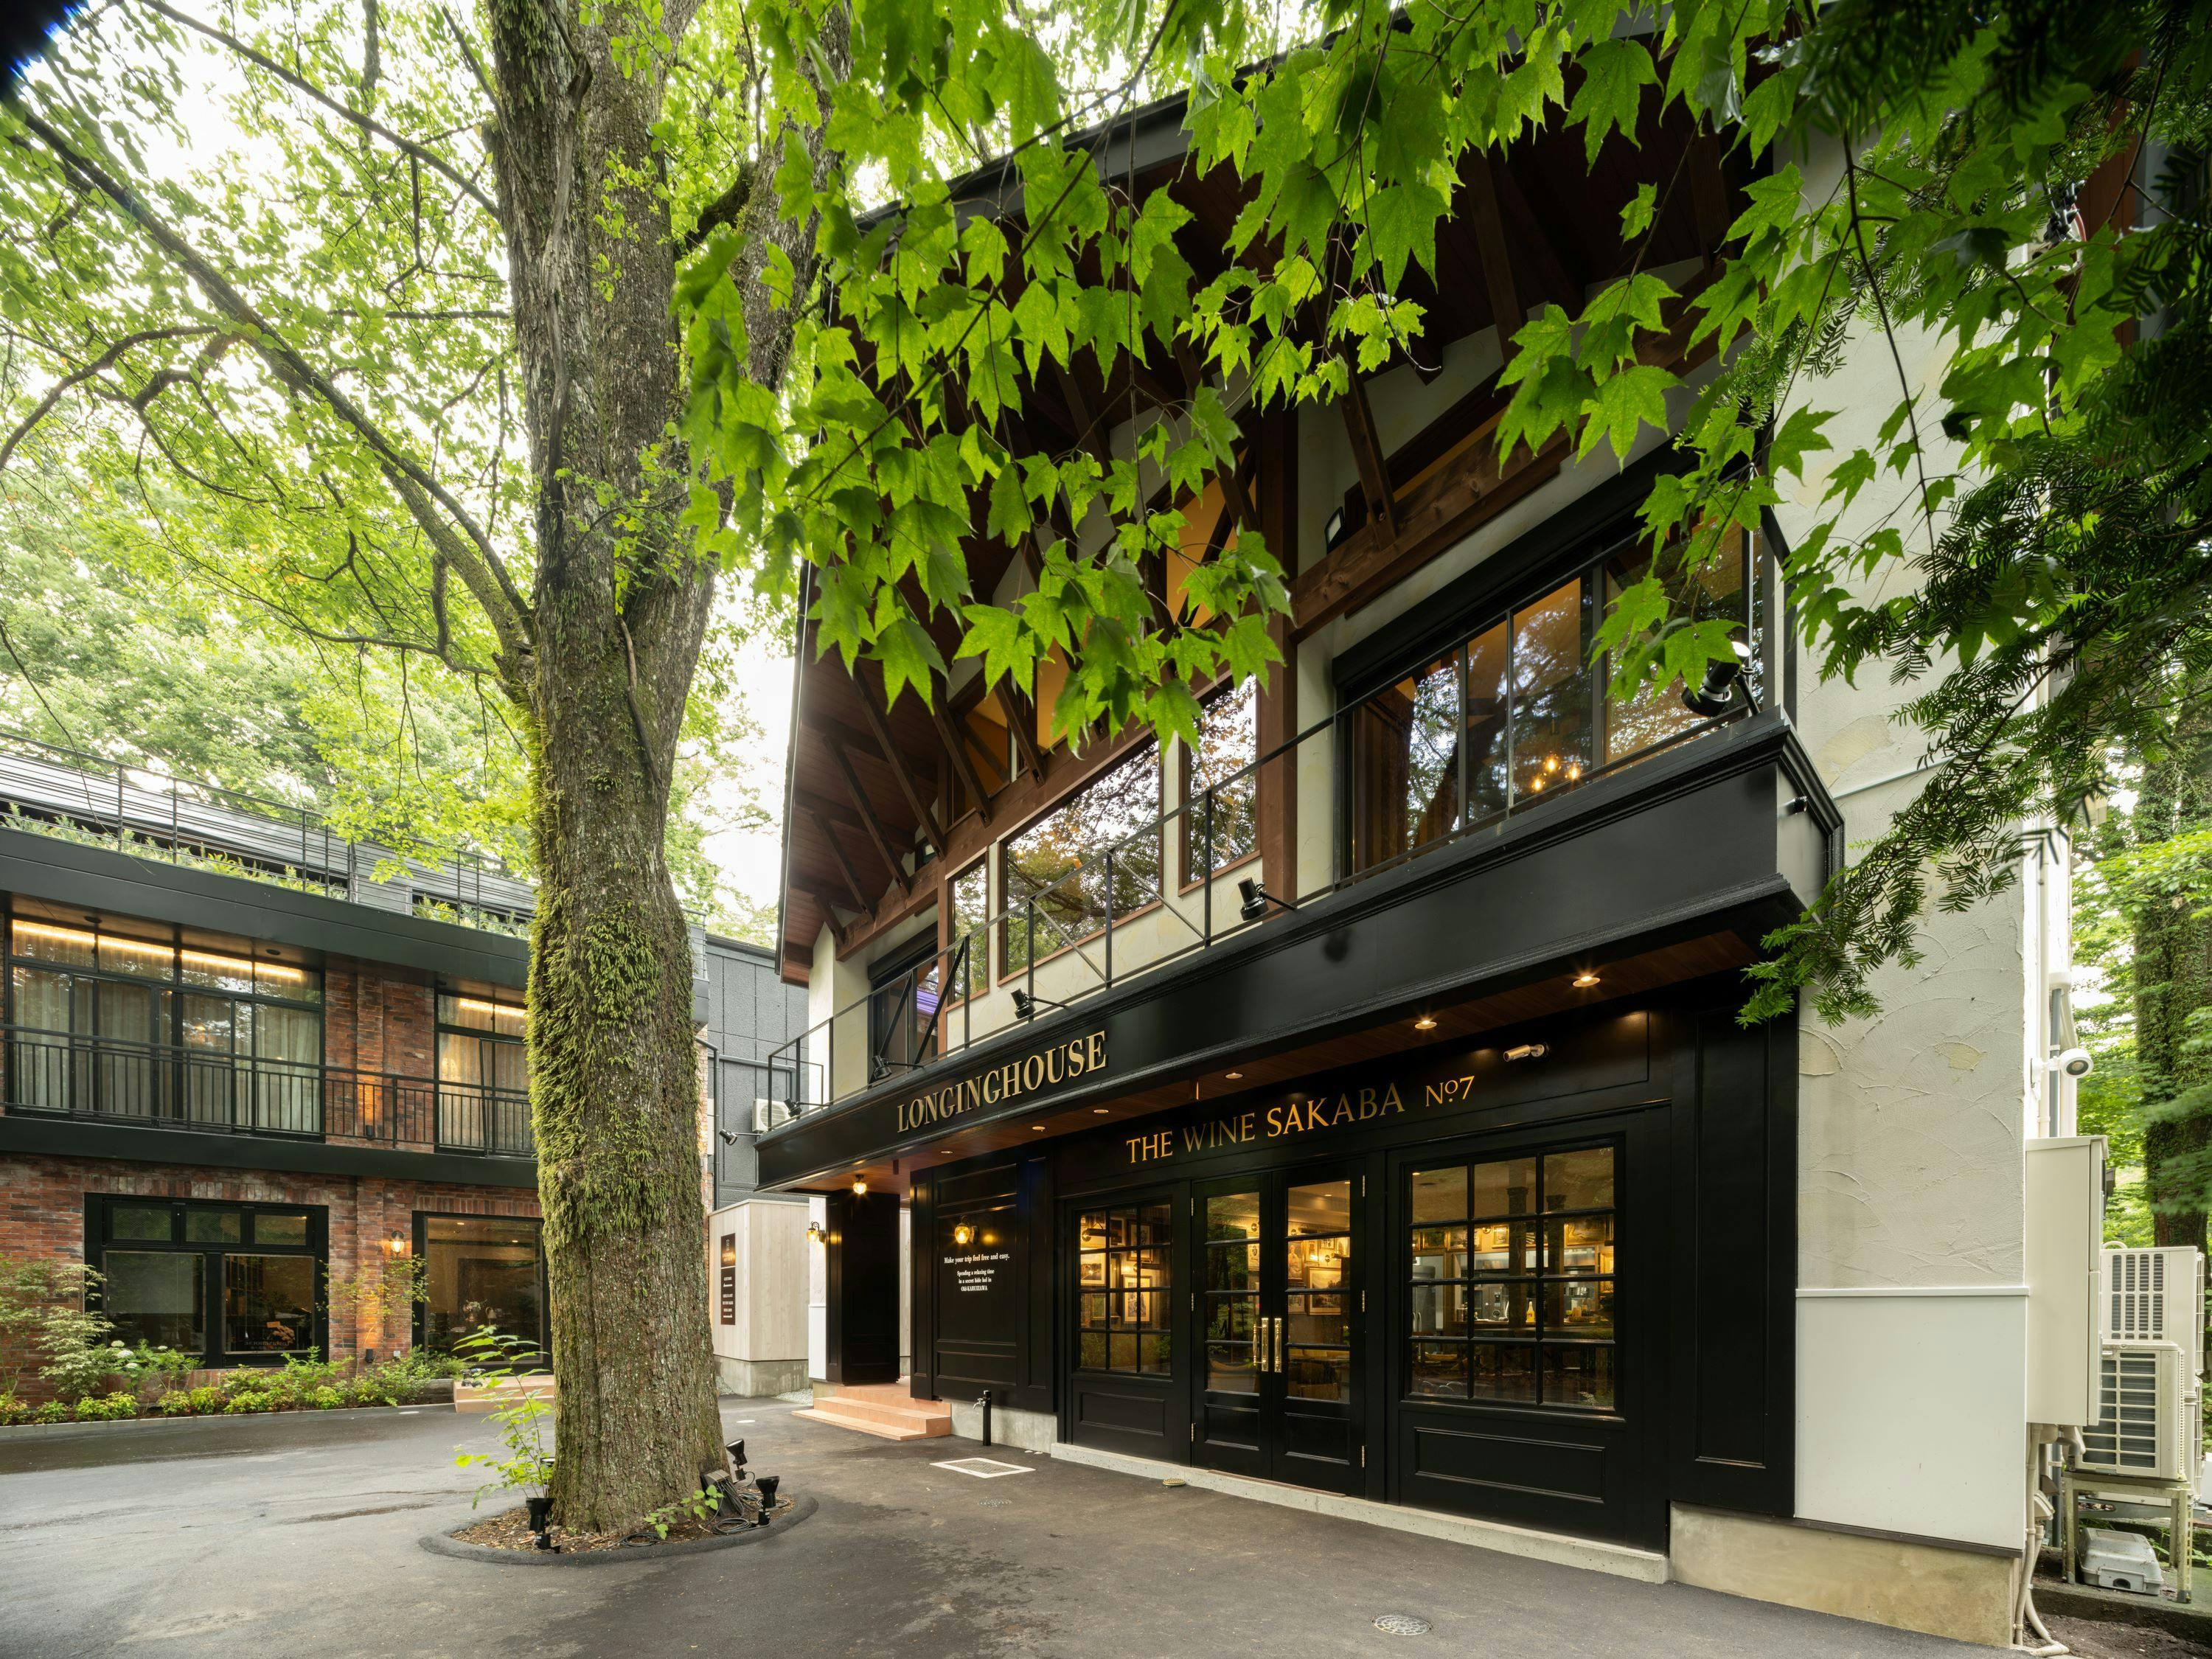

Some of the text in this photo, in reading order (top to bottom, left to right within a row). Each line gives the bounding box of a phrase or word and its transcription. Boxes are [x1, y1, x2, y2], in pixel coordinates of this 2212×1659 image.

[897, 1030, 1107, 1133] LONGINGHOUSE
[1126, 1130, 1173, 1164] THE
[1182, 1113, 1256, 1152] WINE
[1267, 1082, 1405, 1138] SAKABA
[964, 1255, 973, 1264] trip
